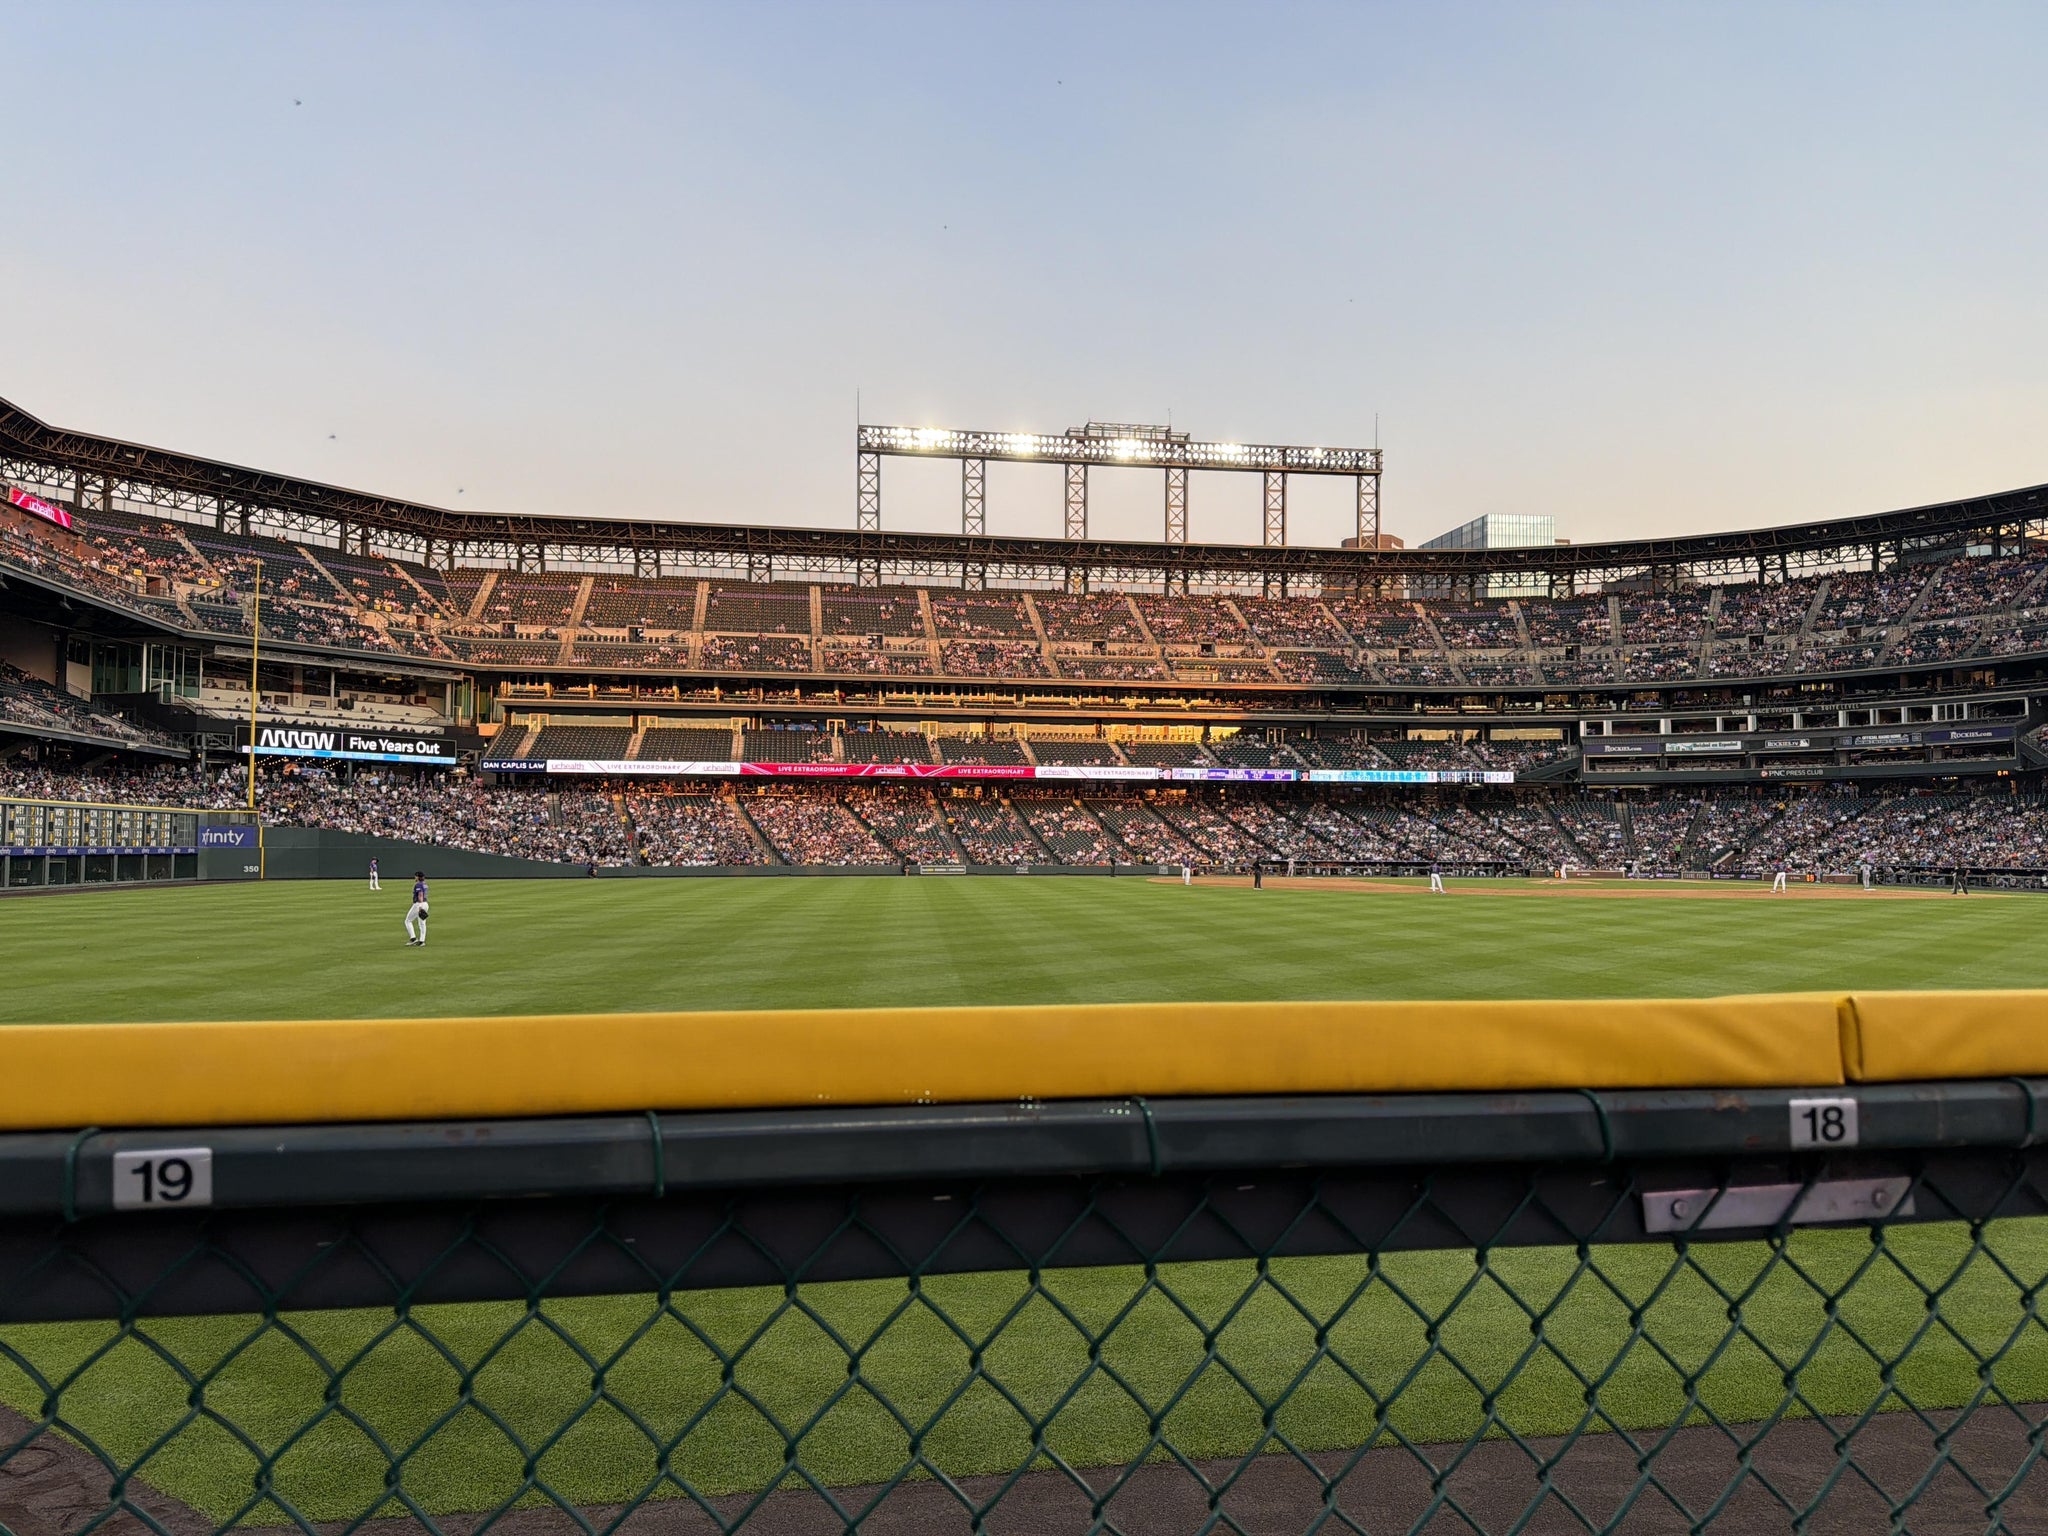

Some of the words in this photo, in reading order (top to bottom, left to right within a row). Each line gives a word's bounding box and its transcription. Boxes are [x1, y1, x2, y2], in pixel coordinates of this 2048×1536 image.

[29, 500, 55, 519] uchealth
[260, 729, 335, 750] ARROW
[349, 737, 377, 750] Five
[379, 738, 414, 753] Years
[416, 741, 440, 755] Out
[551, 762, 585, 770] uchealth
[703, 764, 735, 772] uchealth
[36, 807, 44, 816] 12
[36, 817, 43, 825] 40
[201, 828, 245, 846] xfinity
[243, 865, 259, 873] 350
[1802, 1106, 1845, 1142] 18
[131, 1158, 193, 1202] 19
